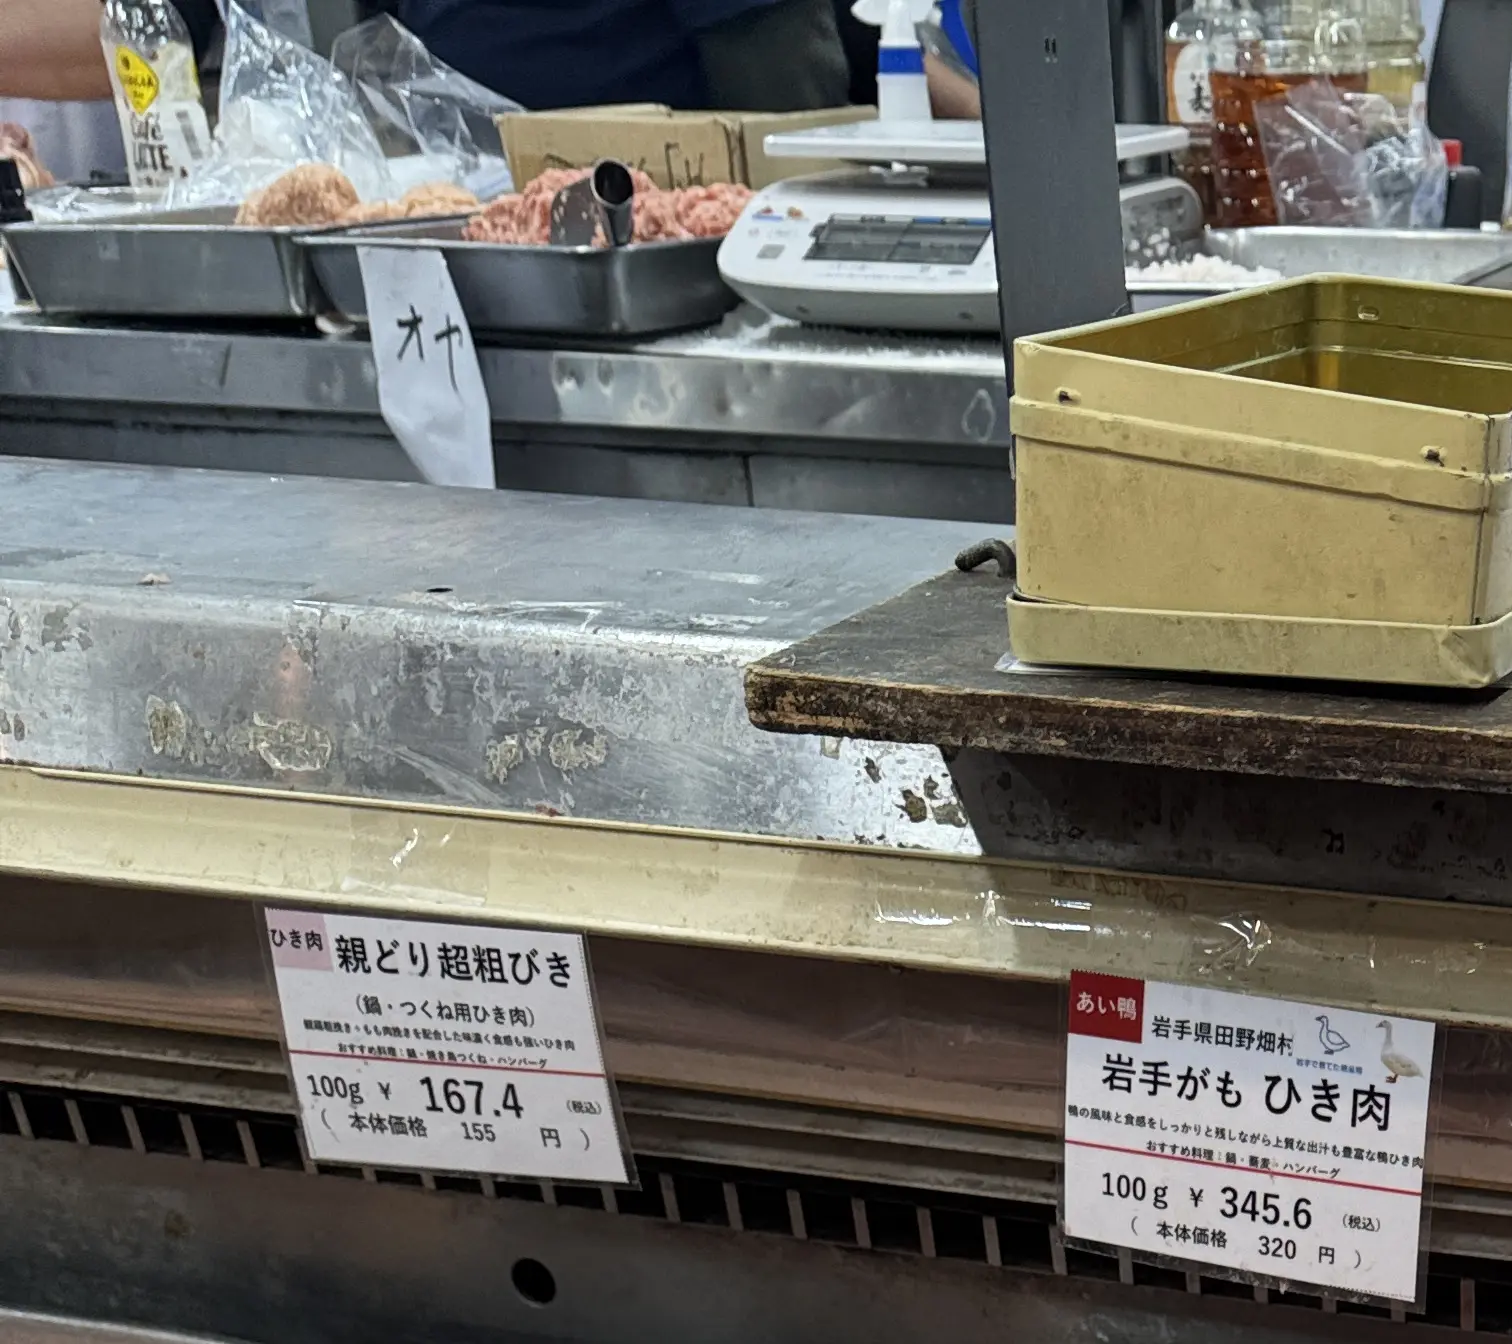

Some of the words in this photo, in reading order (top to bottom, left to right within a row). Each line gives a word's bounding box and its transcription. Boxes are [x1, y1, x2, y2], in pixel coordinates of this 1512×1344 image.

[269, 928, 324, 951] ひき肉
[334, 933, 571, 989] 親どり超粗びき
[1076, 991, 1137, 1021] あい鴨
[1151, 1015, 1294, 1057] 岩手県田野畑村
[307, 1074, 364, 1104] 100g
[419, 1076, 524, 1119] 167.4
[1102, 1052, 1243, 1109] 岩手がも
[1264, 1074, 1391, 1132] ひき肉
[348, 1112, 429, 1138] 本体価格
[460, 1121, 497, 1143] 155
[540, 1128, 562, 1149] 円
[1219, 1185, 1312, 1231] 345.6
[1155, 1219, 1229, 1250] 本体価格
[1257, 1235, 1298, 1261] 320
[1317, 1245, 1336, 1266] 円
